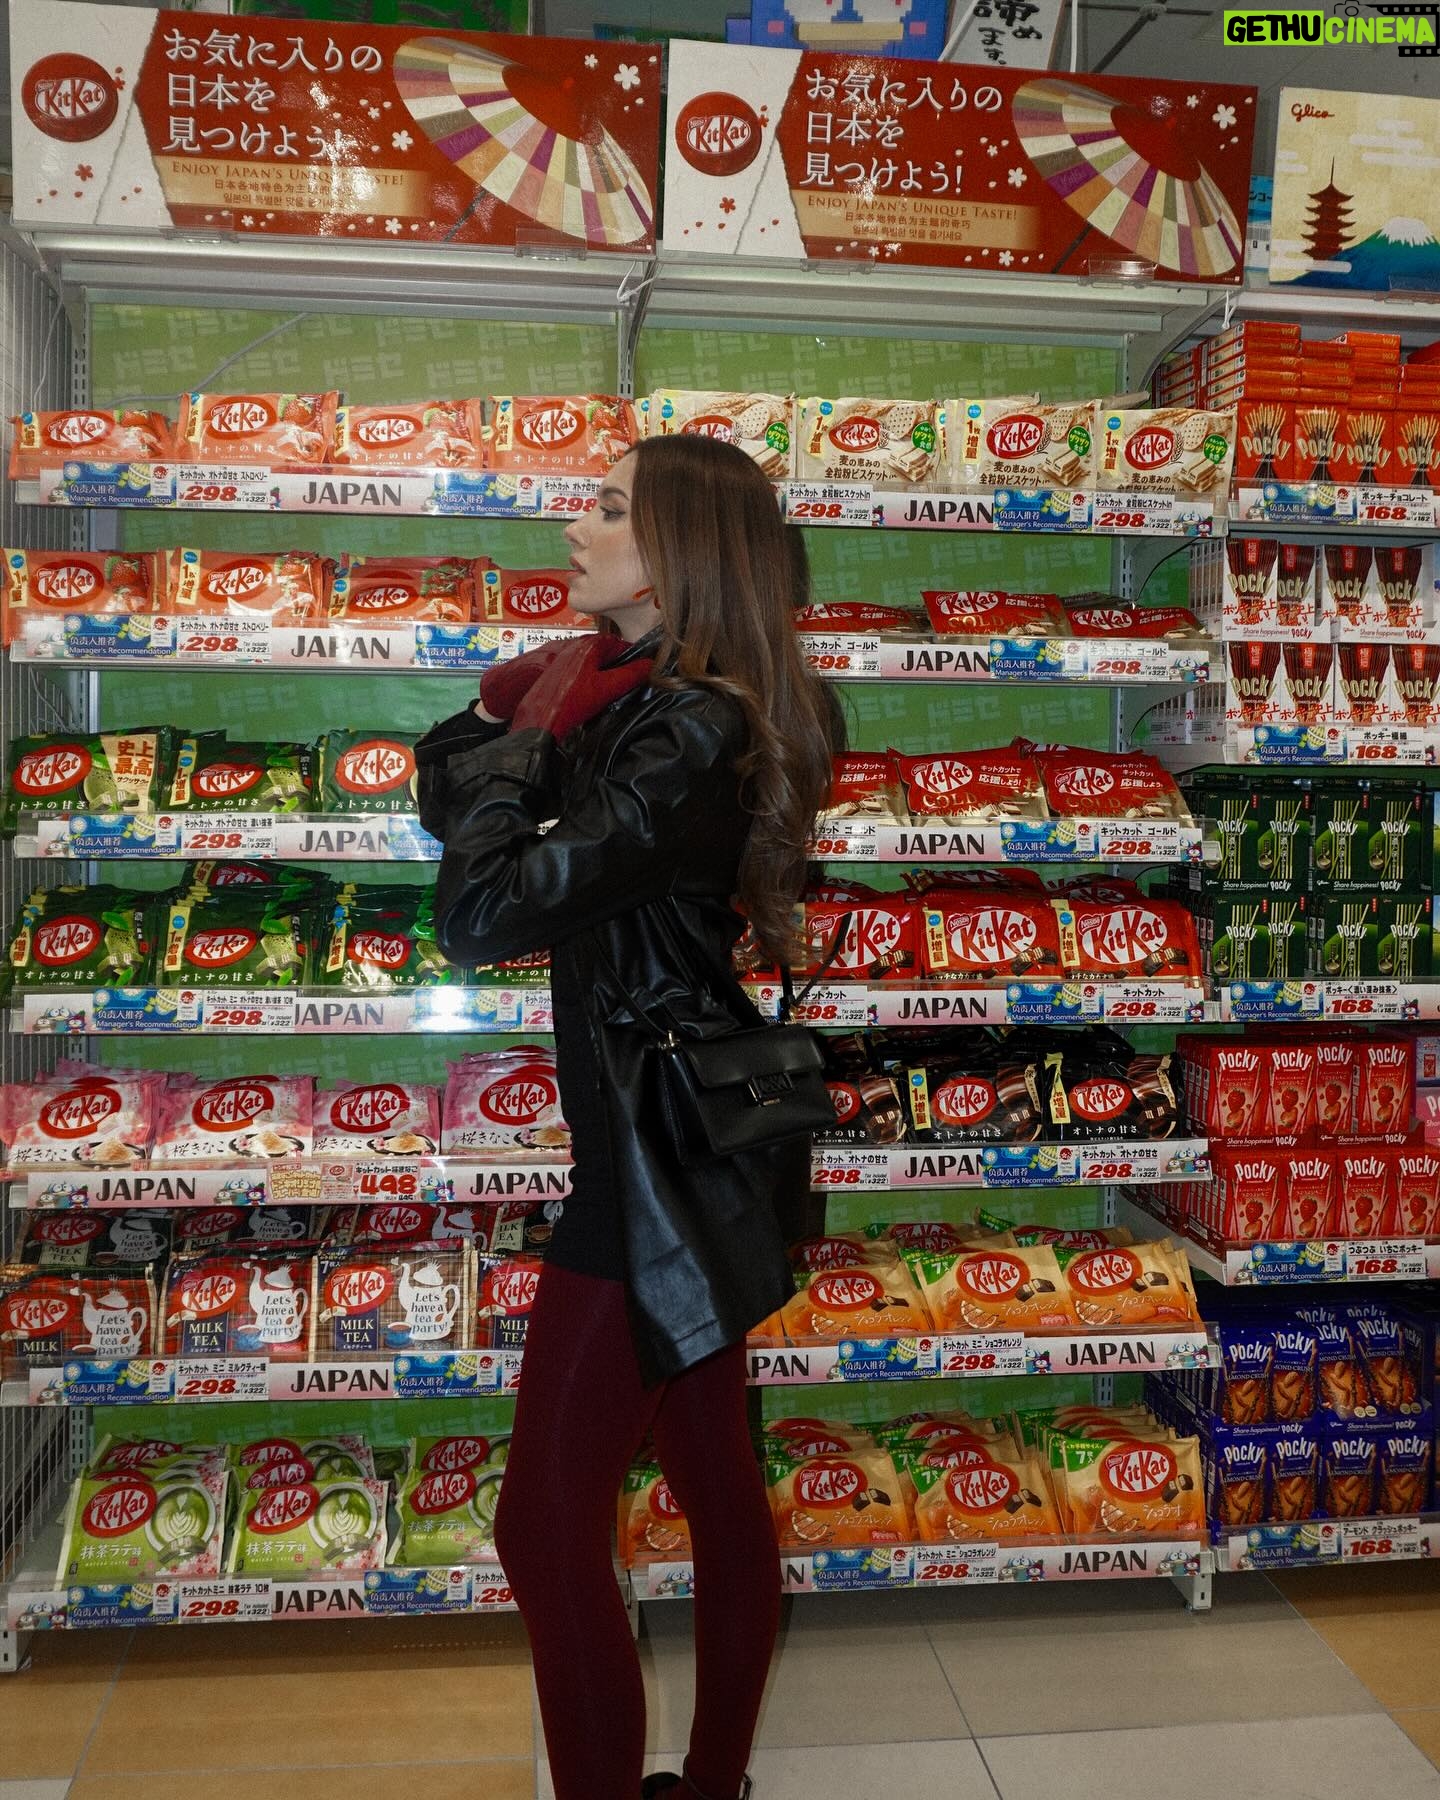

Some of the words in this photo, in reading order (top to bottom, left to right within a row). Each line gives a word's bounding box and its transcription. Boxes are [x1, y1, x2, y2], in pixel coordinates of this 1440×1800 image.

[163, 28, 382, 71] お気に入りの
[44, 79, 101, 118] KitKat
[168, 73, 276, 112] 日本を
[806, 68, 1002, 112] お気に入りの
[1291, 104, 1335, 121] Glico
[807, 111, 904, 148] 日本を
[173, 162, 221, 177] ENJOY
[225, 164, 283, 180] JAPAN'S
[800, 152, 962, 194] 見つけよう!
[808, 196, 849, 208] ENJOY
[854, 198, 907, 212] JAPAN'S
[913, 203, 967, 217] UNIQUE
[974, 206, 1017, 221] TASTE!
[53, 415, 104, 442] KitKat
[365, 418, 415, 442] KitKat
[1135, 433, 1173, 463] KitKat
[839, 455, 880, 467] 麦の恵みの
[993, 462, 1036, 474] 麦の恵みの
[109, 496, 171, 504] Recommendation
[303, 481, 401, 506] JAPAN
[790, 488, 818, 498] キットカット
[1095, 498, 1123, 508] キットカット
[1362, 492, 1427, 502] ポッキーチョコレート
[905, 499, 994, 524] JAPAN
[213, 567, 262, 594] KitKat
[516, 585, 562, 613] KitKat
[291, 635, 390, 660] JAPAN
[1137, 648, 1166, 656] ゴールド
[901, 650, 990, 672] JAPAN
[118, 741, 153, 757] 史上
[1260, 755, 1292, 763] Manager's
[114, 758, 152, 776] 最高
[921, 761, 970, 793] KitKat
[216, 819, 247, 827] オトナの甘さ
[1101, 827, 1142, 836] キットカット
[1148, 827, 1177, 835] ゴールド
[895, 834, 984, 855] JAPAN
[1241, 881, 1269, 889] happiness!
[45, 923, 93, 957] KitKat
[1091, 911, 1164, 963] KitKat
[1123, 988, 1164, 997] キットカット
[898, 997, 987, 1019] JAPAN
[97, 1020, 133, 1029] Manager's
[136, 1020, 197, 1029] Recommendation
[207, 1088, 262, 1122] KitKat
[493, 1082, 547, 1116] KitKat
[1082, 1085, 1122, 1112] KitKat
[848, 1155, 888, 1164] オトナの甘さ
[1082, 1150, 1115, 1158] キットカット
[1120, 1150, 1158, 1158] オトナの甘さ
[96, 1177, 196, 1201] JAPAN
[470, 1172, 566, 1196] JAPAN
[988, 1177, 1020, 1185] Manager's
[1084, 1254, 1130, 1287] KitKat
[187, 1276, 235, 1311] KitKat
[266, 1296, 291, 1306] Let's
[415, 1293, 440, 1302] Let's
[825, 1279, 873, 1304] KitKat
[411, 1302, 435, 1312] have
[189, 1322, 223, 1334] MILK
[340, 1319, 374, 1330] MILK
[414, 1314, 432, 1323] tea
[192, 1335, 218, 1346] TEA
[343, 1332, 371, 1343] TEA
[985, 1338, 1022, 1347] ショコラオレンジ
[1066, 1341, 1156, 1366] JAPAN
[213, 1365, 225, 1373] ミニ
[291, 1369, 389, 1393] JAPAN
[1116, 1450, 1166, 1492] KitKat
[808, 1469, 856, 1500] KitKat
[260, 1491, 310, 1526] KitKat
[959, 1548, 996, 1559] ショコラオレンジ
[1059, 1549, 1146, 1575] JAPAN
[72, 1616, 109, 1626] Manager's
[111, 1615, 173, 1624] Recommendation
